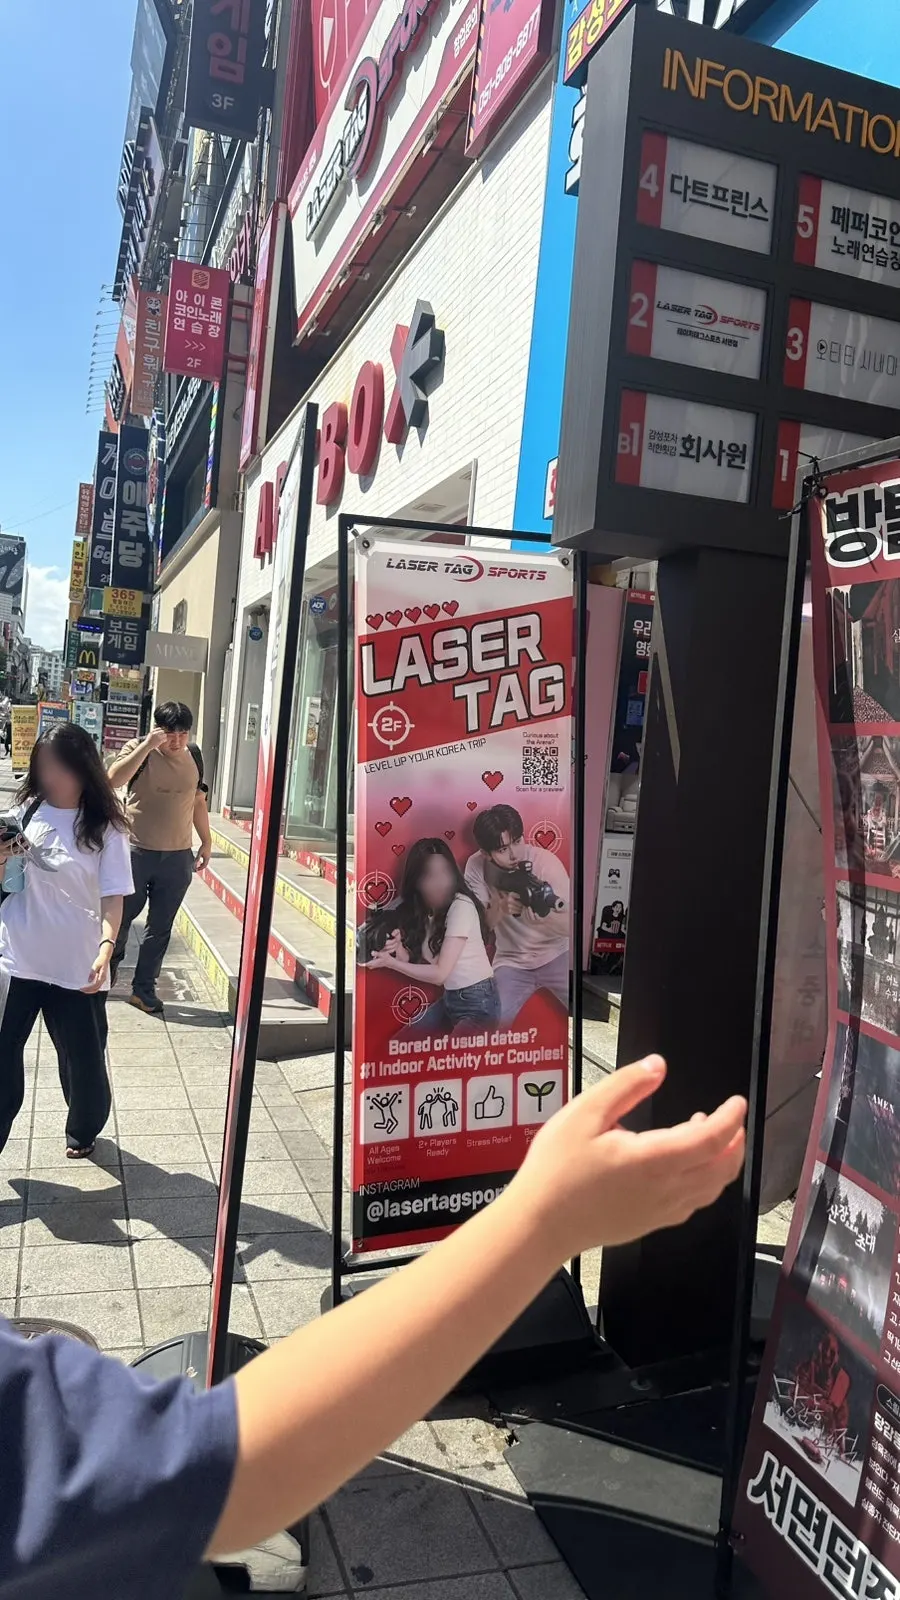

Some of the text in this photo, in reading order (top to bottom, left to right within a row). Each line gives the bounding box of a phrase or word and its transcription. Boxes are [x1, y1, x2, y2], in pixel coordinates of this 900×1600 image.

[211, 93, 235, 110] 3F
[638, 164, 660, 199] 4
[669, 171, 770, 225] 다트프린스
[796, 204, 815, 239] 5
[173, 303, 222, 325] 코인노래
[629, 292, 649, 330] 2
[656, 301, 761, 332] LASER TAG SPORTS
[785, 326, 804, 361] 3
[186, 357, 202, 368] 2F
[617, 422, 641, 457] B1
[648, 429, 678, 444] 감성포차
[679, 433, 748, 470] 회사원
[778, 448, 790, 482] 1
[386, 557, 548, 582] LASER TAG SPORTS
[111, 588, 136, 602] 365
[108, 619, 139, 636] 보드
[107, 634, 139, 652] 게임
[360, 612, 546, 698] LASER
[453, 662, 566, 734] TAG
[381, 716, 402, 732] 2F
[364, 738, 487, 775] LEVEL UP YOUR KOREA TRIP
[388, 1028, 538, 1056] Bored of usual dates?
[360, 1045, 564, 1080] #1 Indoor Activity for Couples!
[369, 1144, 400, 1157] All Ages
[426, 1147, 450, 1158] Ready
[429, 1137, 457, 1150] Players
[466, 1136, 491, 1148] Stress
[491, 1135, 513, 1147] Relief
[367, 1154, 402, 1166] Welcome
[359, 1178, 421, 1197] INSTAGRAM
[367, 1183, 508, 1222] @lasertagspor
